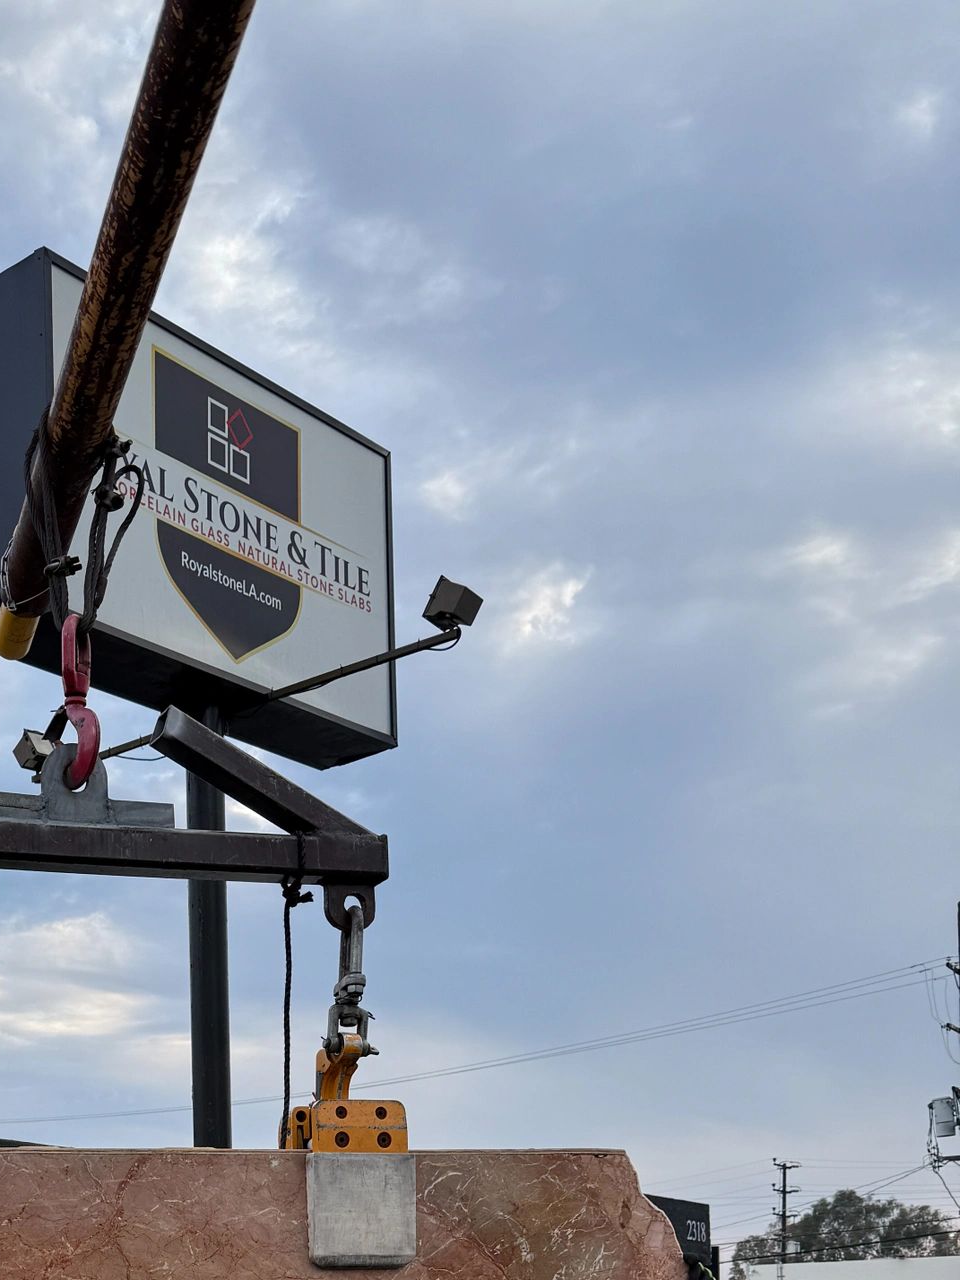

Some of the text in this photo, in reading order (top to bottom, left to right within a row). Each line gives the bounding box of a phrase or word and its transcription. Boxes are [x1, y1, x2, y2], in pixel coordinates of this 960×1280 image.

[117, 480, 372, 613] ORELAIN GLASS NATURAL STONE SLABS
[121, 452, 371, 597] YAL STONE & TILE
[180, 550, 282, 611] RoyalstoneLA.com
[686, 1219, 707, 1243] 2318
